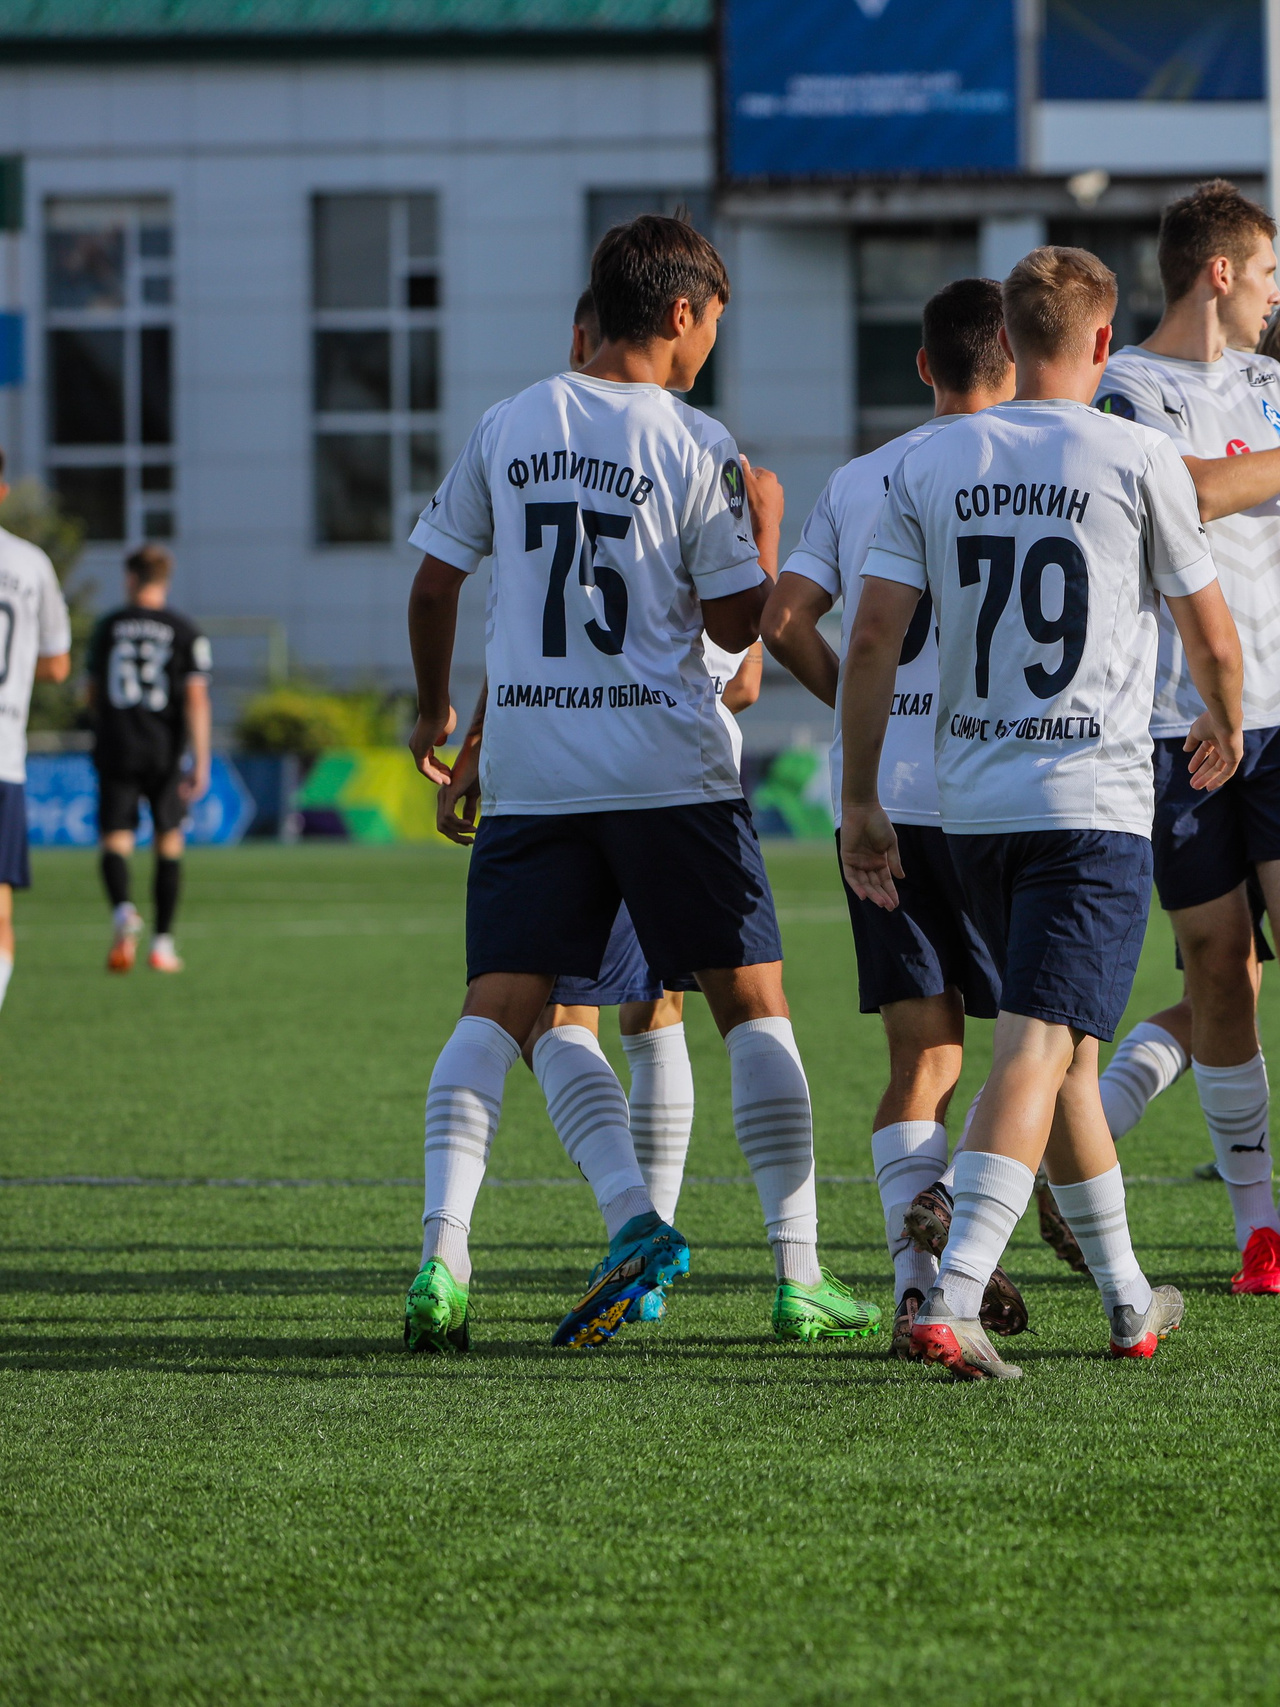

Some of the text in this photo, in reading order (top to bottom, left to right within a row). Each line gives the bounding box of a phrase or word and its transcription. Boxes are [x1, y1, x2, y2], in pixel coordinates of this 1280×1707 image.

[508, 449, 655, 506] ФИЛИППОВ
[954, 483, 1091, 524] СОРОКИН
[524, 501, 632, 658] 75
[956, 534, 1089, 700] 79
[497, 684, 604, 709] САМАРСКАЯ
[1014, 715, 1101, 741] ОБЛАСТЬ
